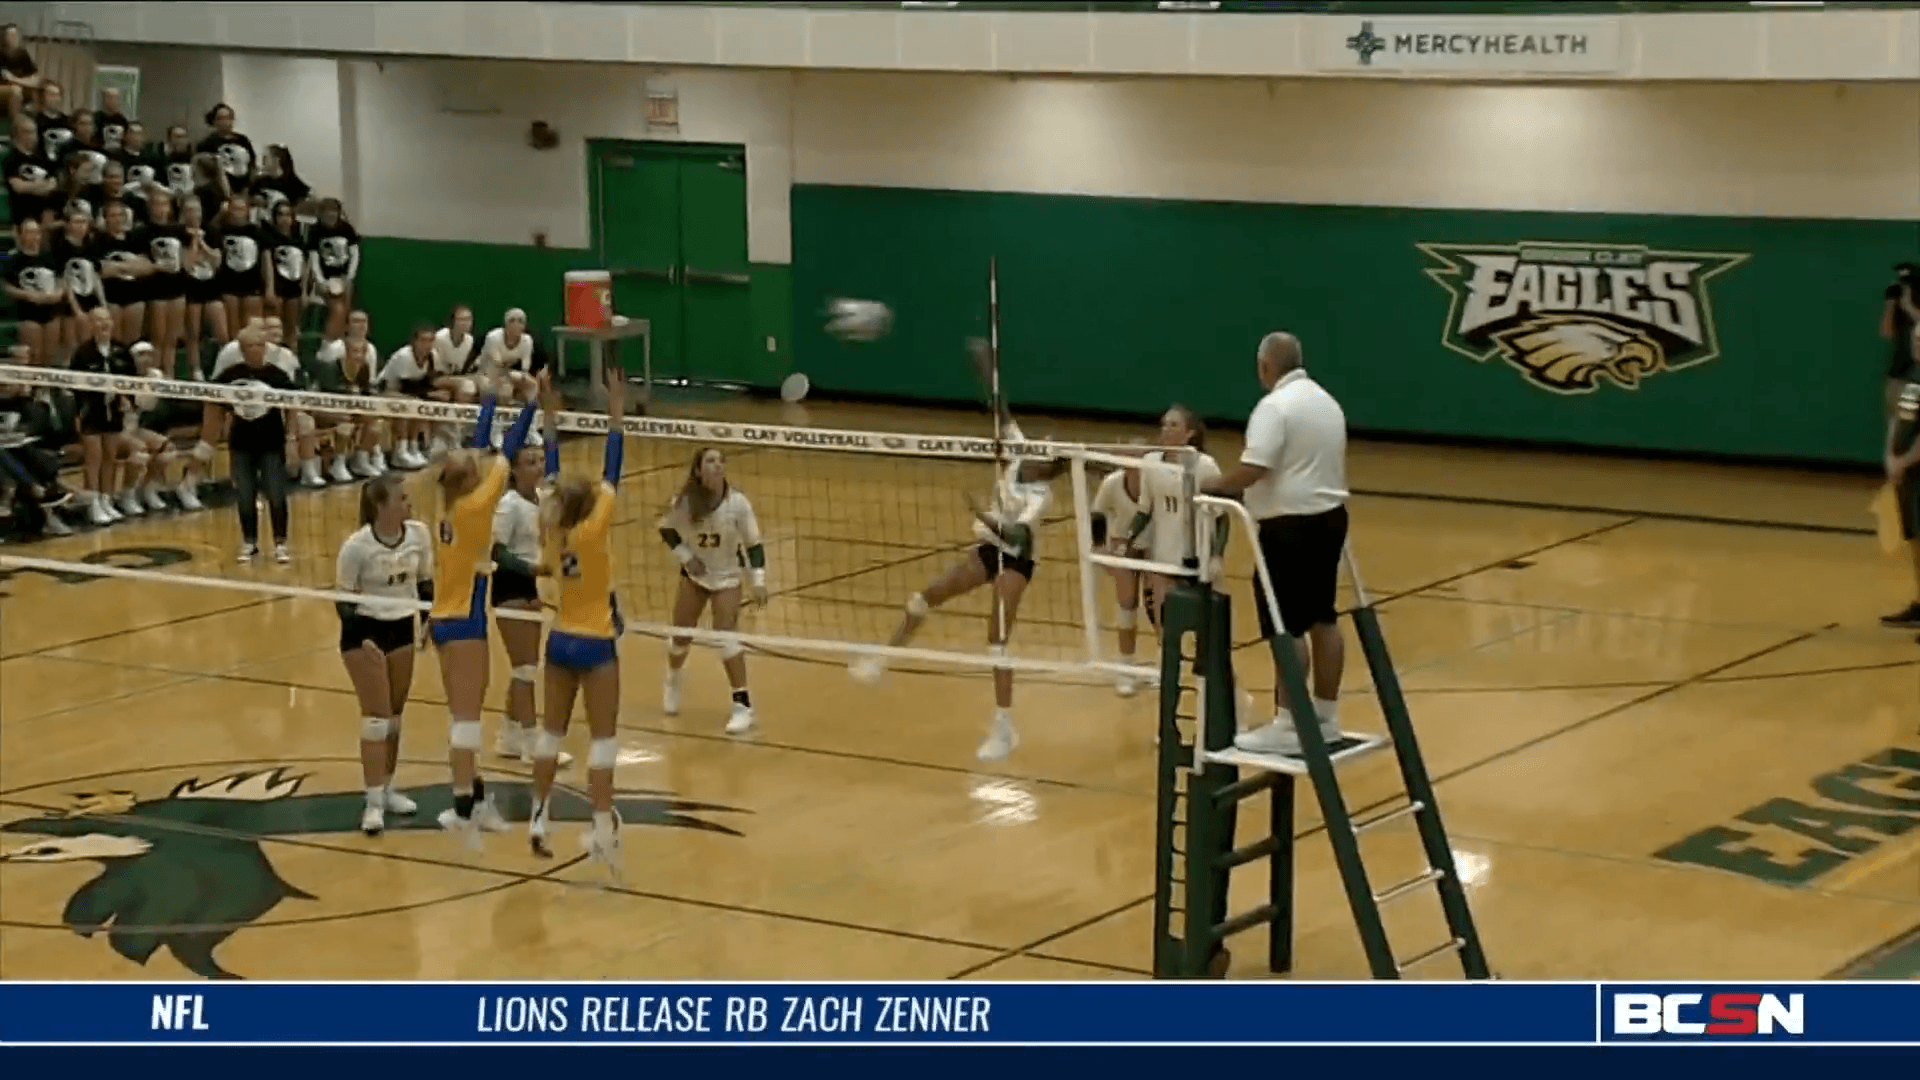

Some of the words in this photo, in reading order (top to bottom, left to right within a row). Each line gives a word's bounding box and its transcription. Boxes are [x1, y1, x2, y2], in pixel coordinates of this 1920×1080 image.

[1394, 33, 1588, 54] MERCYHEALTH
[1456, 253, 1704, 346] EAGLES
[300, 395, 376, 411] VOLLEYBALL
[417, 403, 450, 417] CLAY
[743, 427, 777, 441] CLAY
[783, 430, 869, 448] VOLLEYBALL
[917, 439, 953, 453] CLAY
[698, 532, 721, 549] 23
